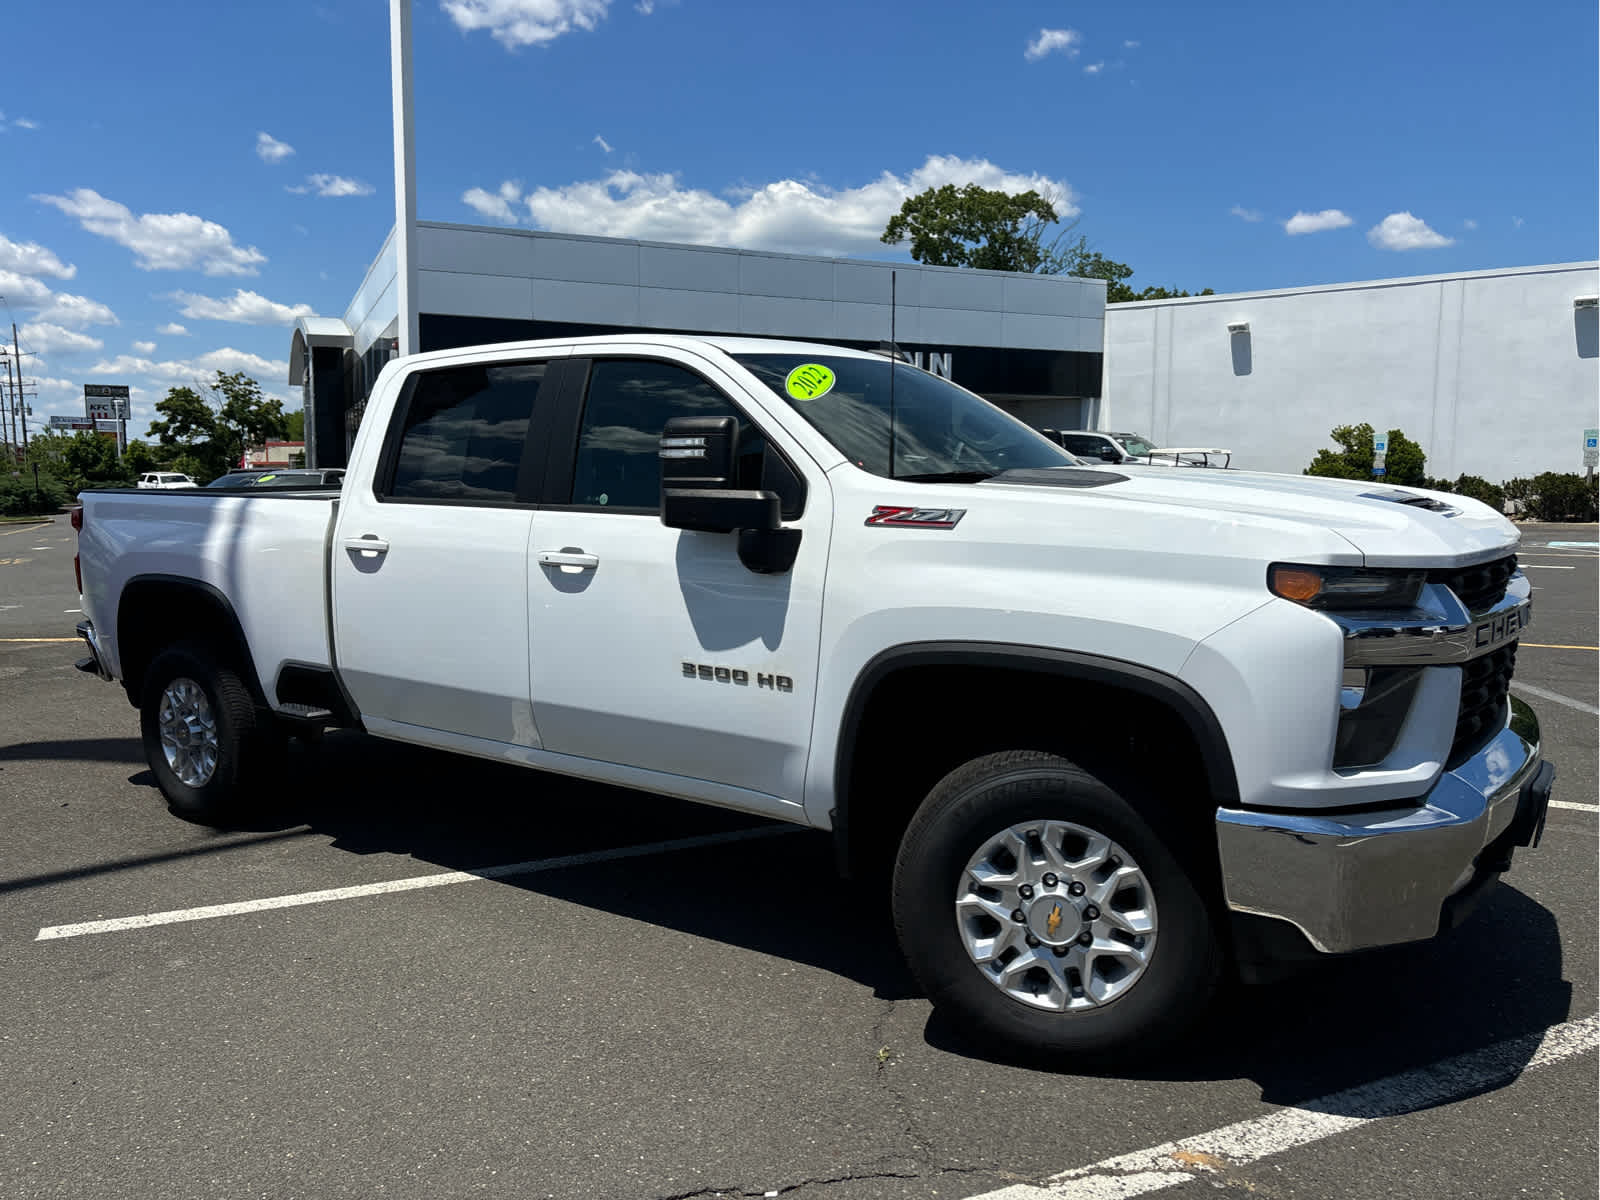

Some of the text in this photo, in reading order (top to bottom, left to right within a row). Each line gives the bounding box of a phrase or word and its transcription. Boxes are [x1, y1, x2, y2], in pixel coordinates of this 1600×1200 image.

[793, 366, 828, 396] 2022
[681, 662, 793, 693] 3500 HD
